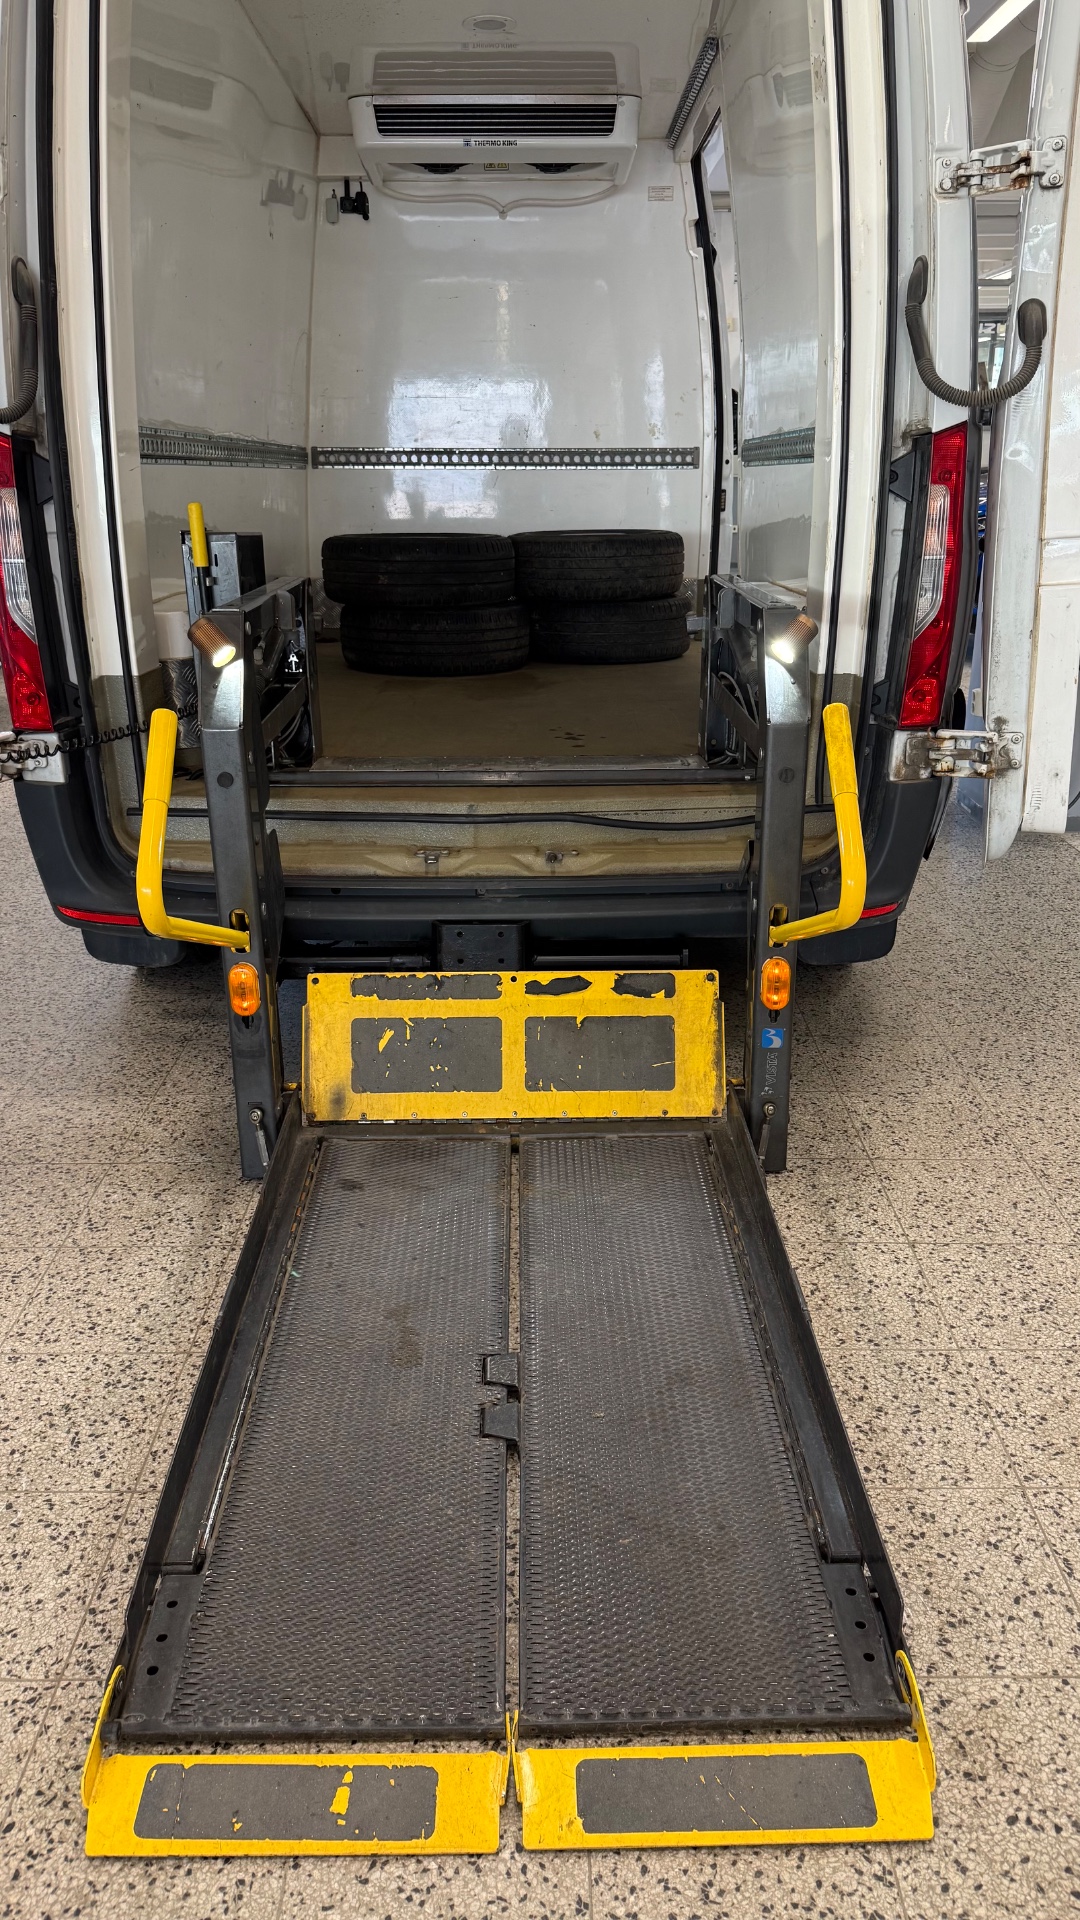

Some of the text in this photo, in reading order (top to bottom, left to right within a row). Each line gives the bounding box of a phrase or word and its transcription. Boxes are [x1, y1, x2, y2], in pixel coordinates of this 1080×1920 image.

[474, 139, 518, 147] THERMO KING
[765, 1052, 778, 1086] VISTA
